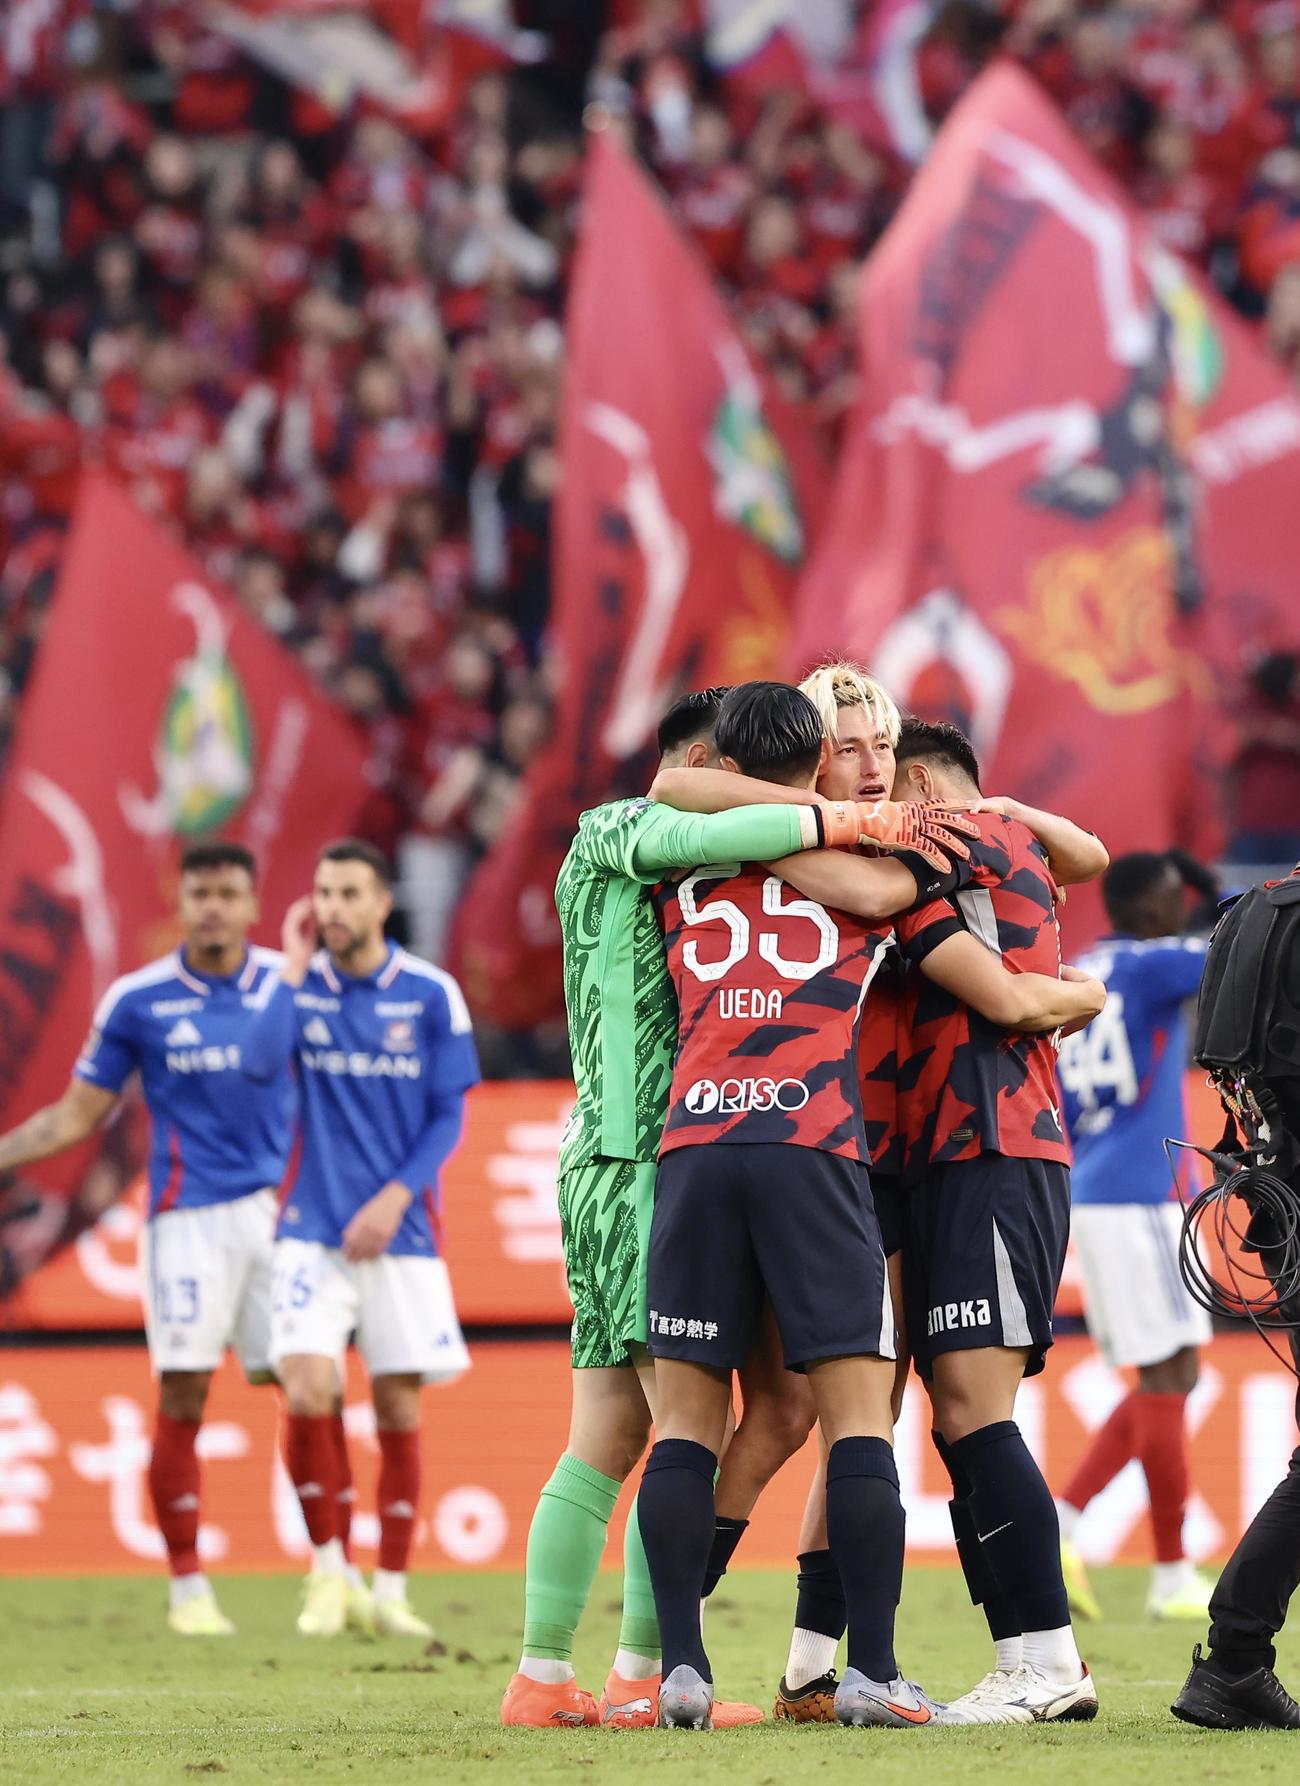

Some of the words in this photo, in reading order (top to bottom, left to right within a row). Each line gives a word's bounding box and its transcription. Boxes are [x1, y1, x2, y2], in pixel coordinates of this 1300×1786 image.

[677, 863, 839, 982] 55
[719, 988, 782, 1019] UEDA
[718, 1077, 809, 1114] RISO
[657, 1315, 719, 1341] 高砂熱学
